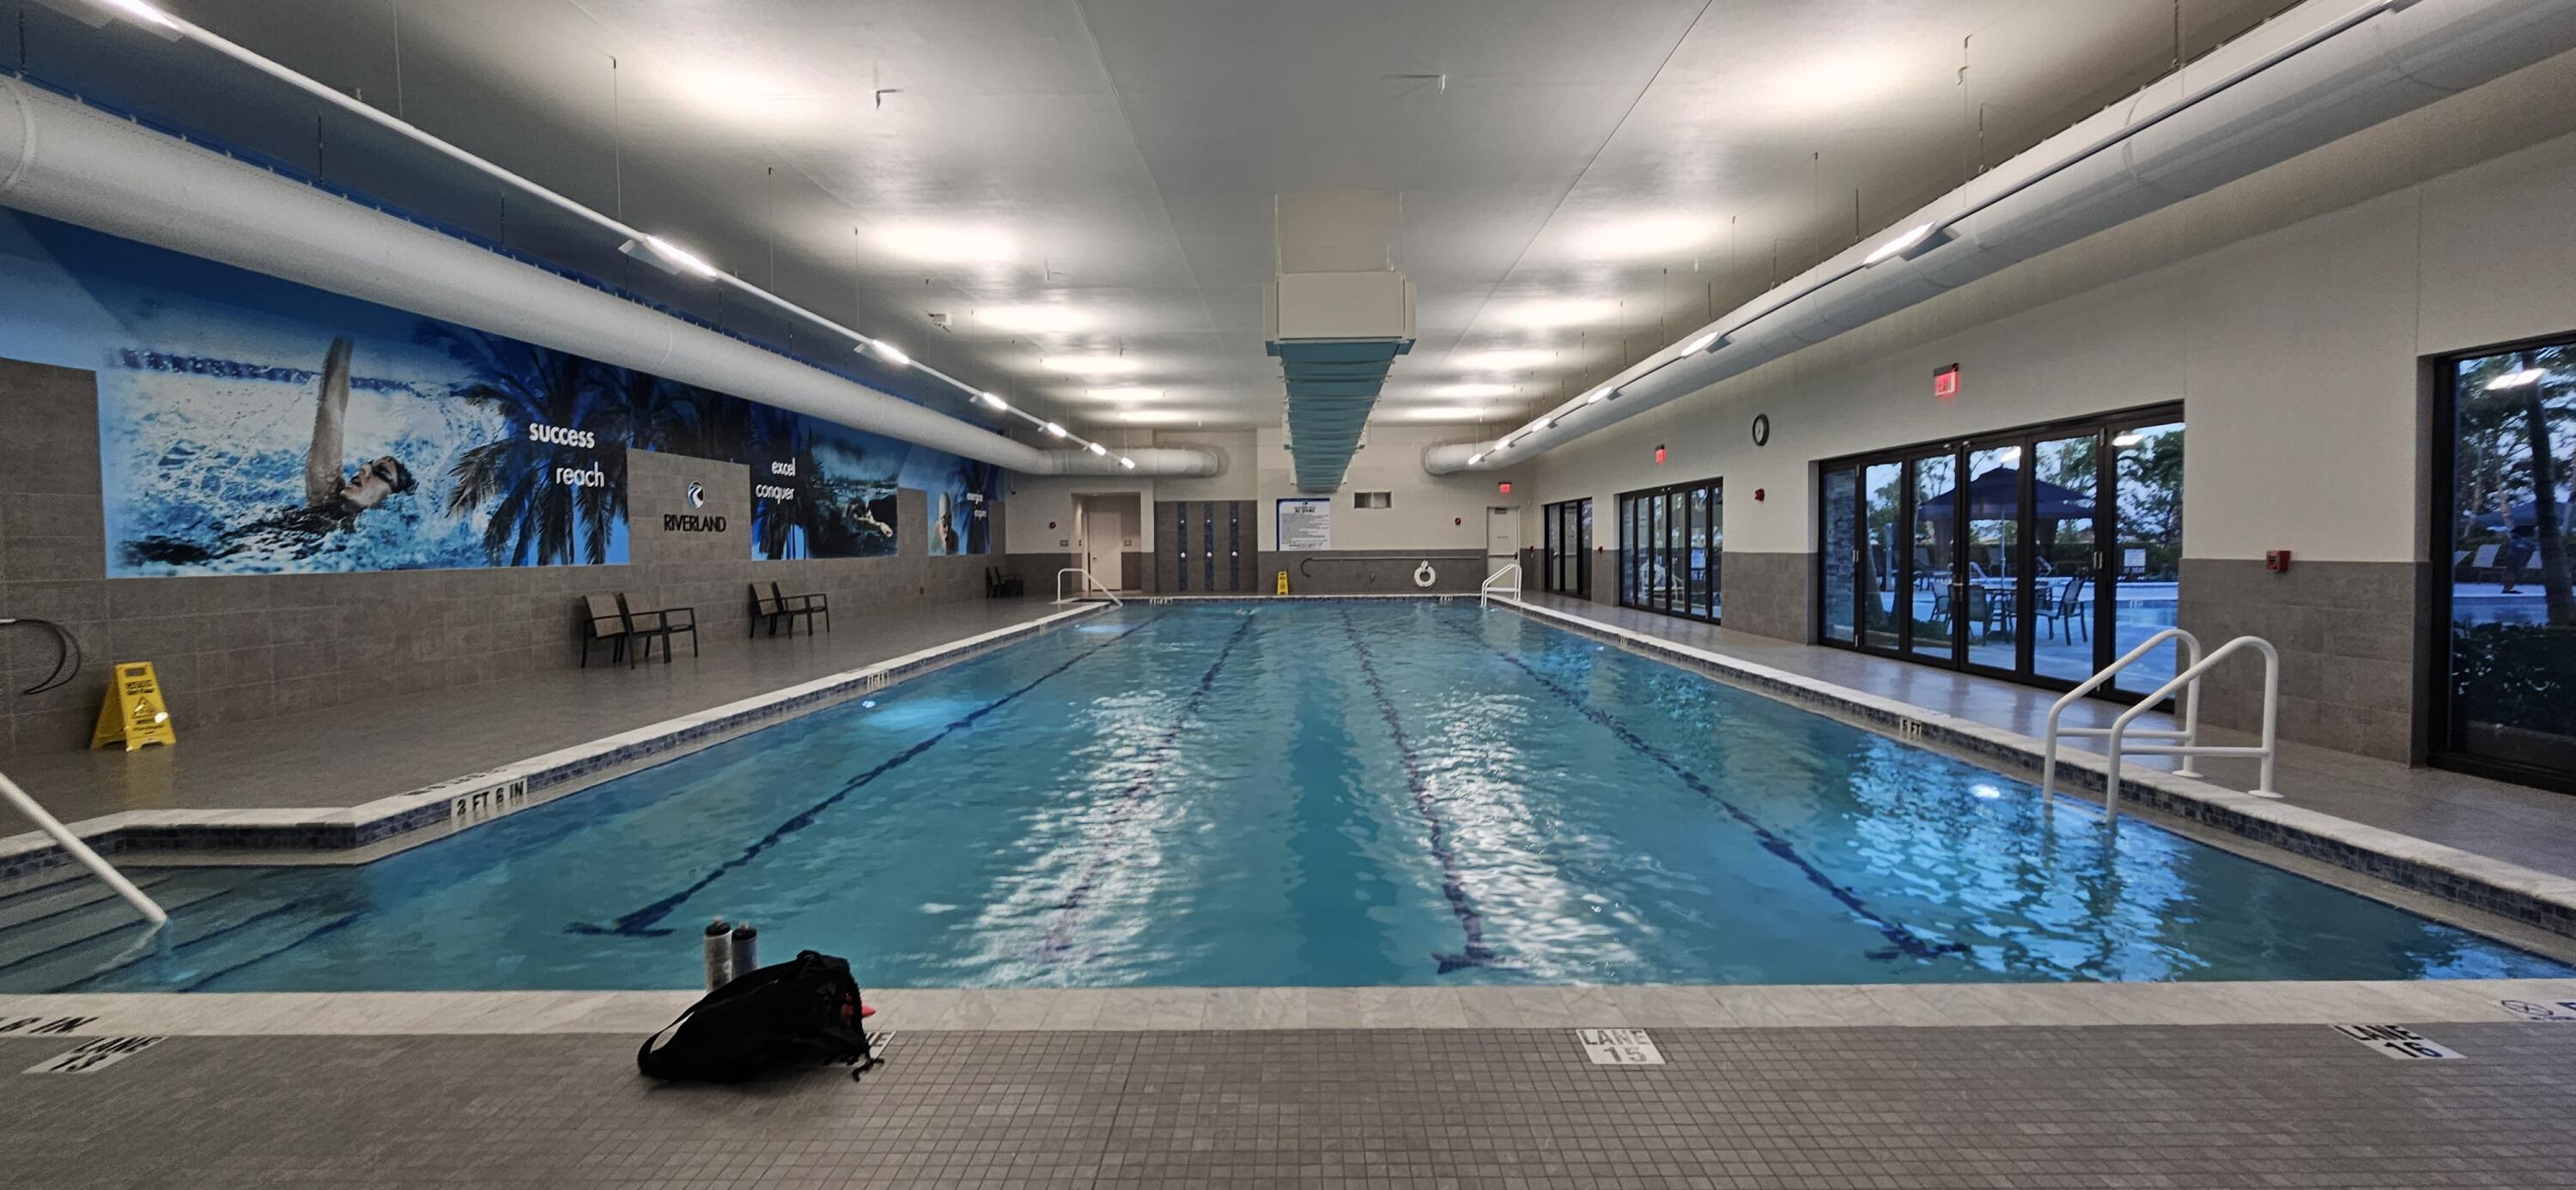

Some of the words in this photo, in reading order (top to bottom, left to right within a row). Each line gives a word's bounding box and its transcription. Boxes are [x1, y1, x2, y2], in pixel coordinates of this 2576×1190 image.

[529, 422, 595, 448] success
[556, 461, 605, 487] reach
[772, 457, 795, 477] excel
[756, 483, 794, 505] conquer
[664, 513, 726, 532] RIVERLAND
[472, 791, 489, 811] FT
[495, 786, 504, 804] 6
[509, 780, 525, 799] IN
[1580, 1029, 1650, 1045] LANE
[2334, 1025, 2423, 1041] LANE
[73, 1036, 163, 1053] LANE
[2384, 1041, 2443, 1058] 16
[1604, 1047, 1647, 1062] 15
